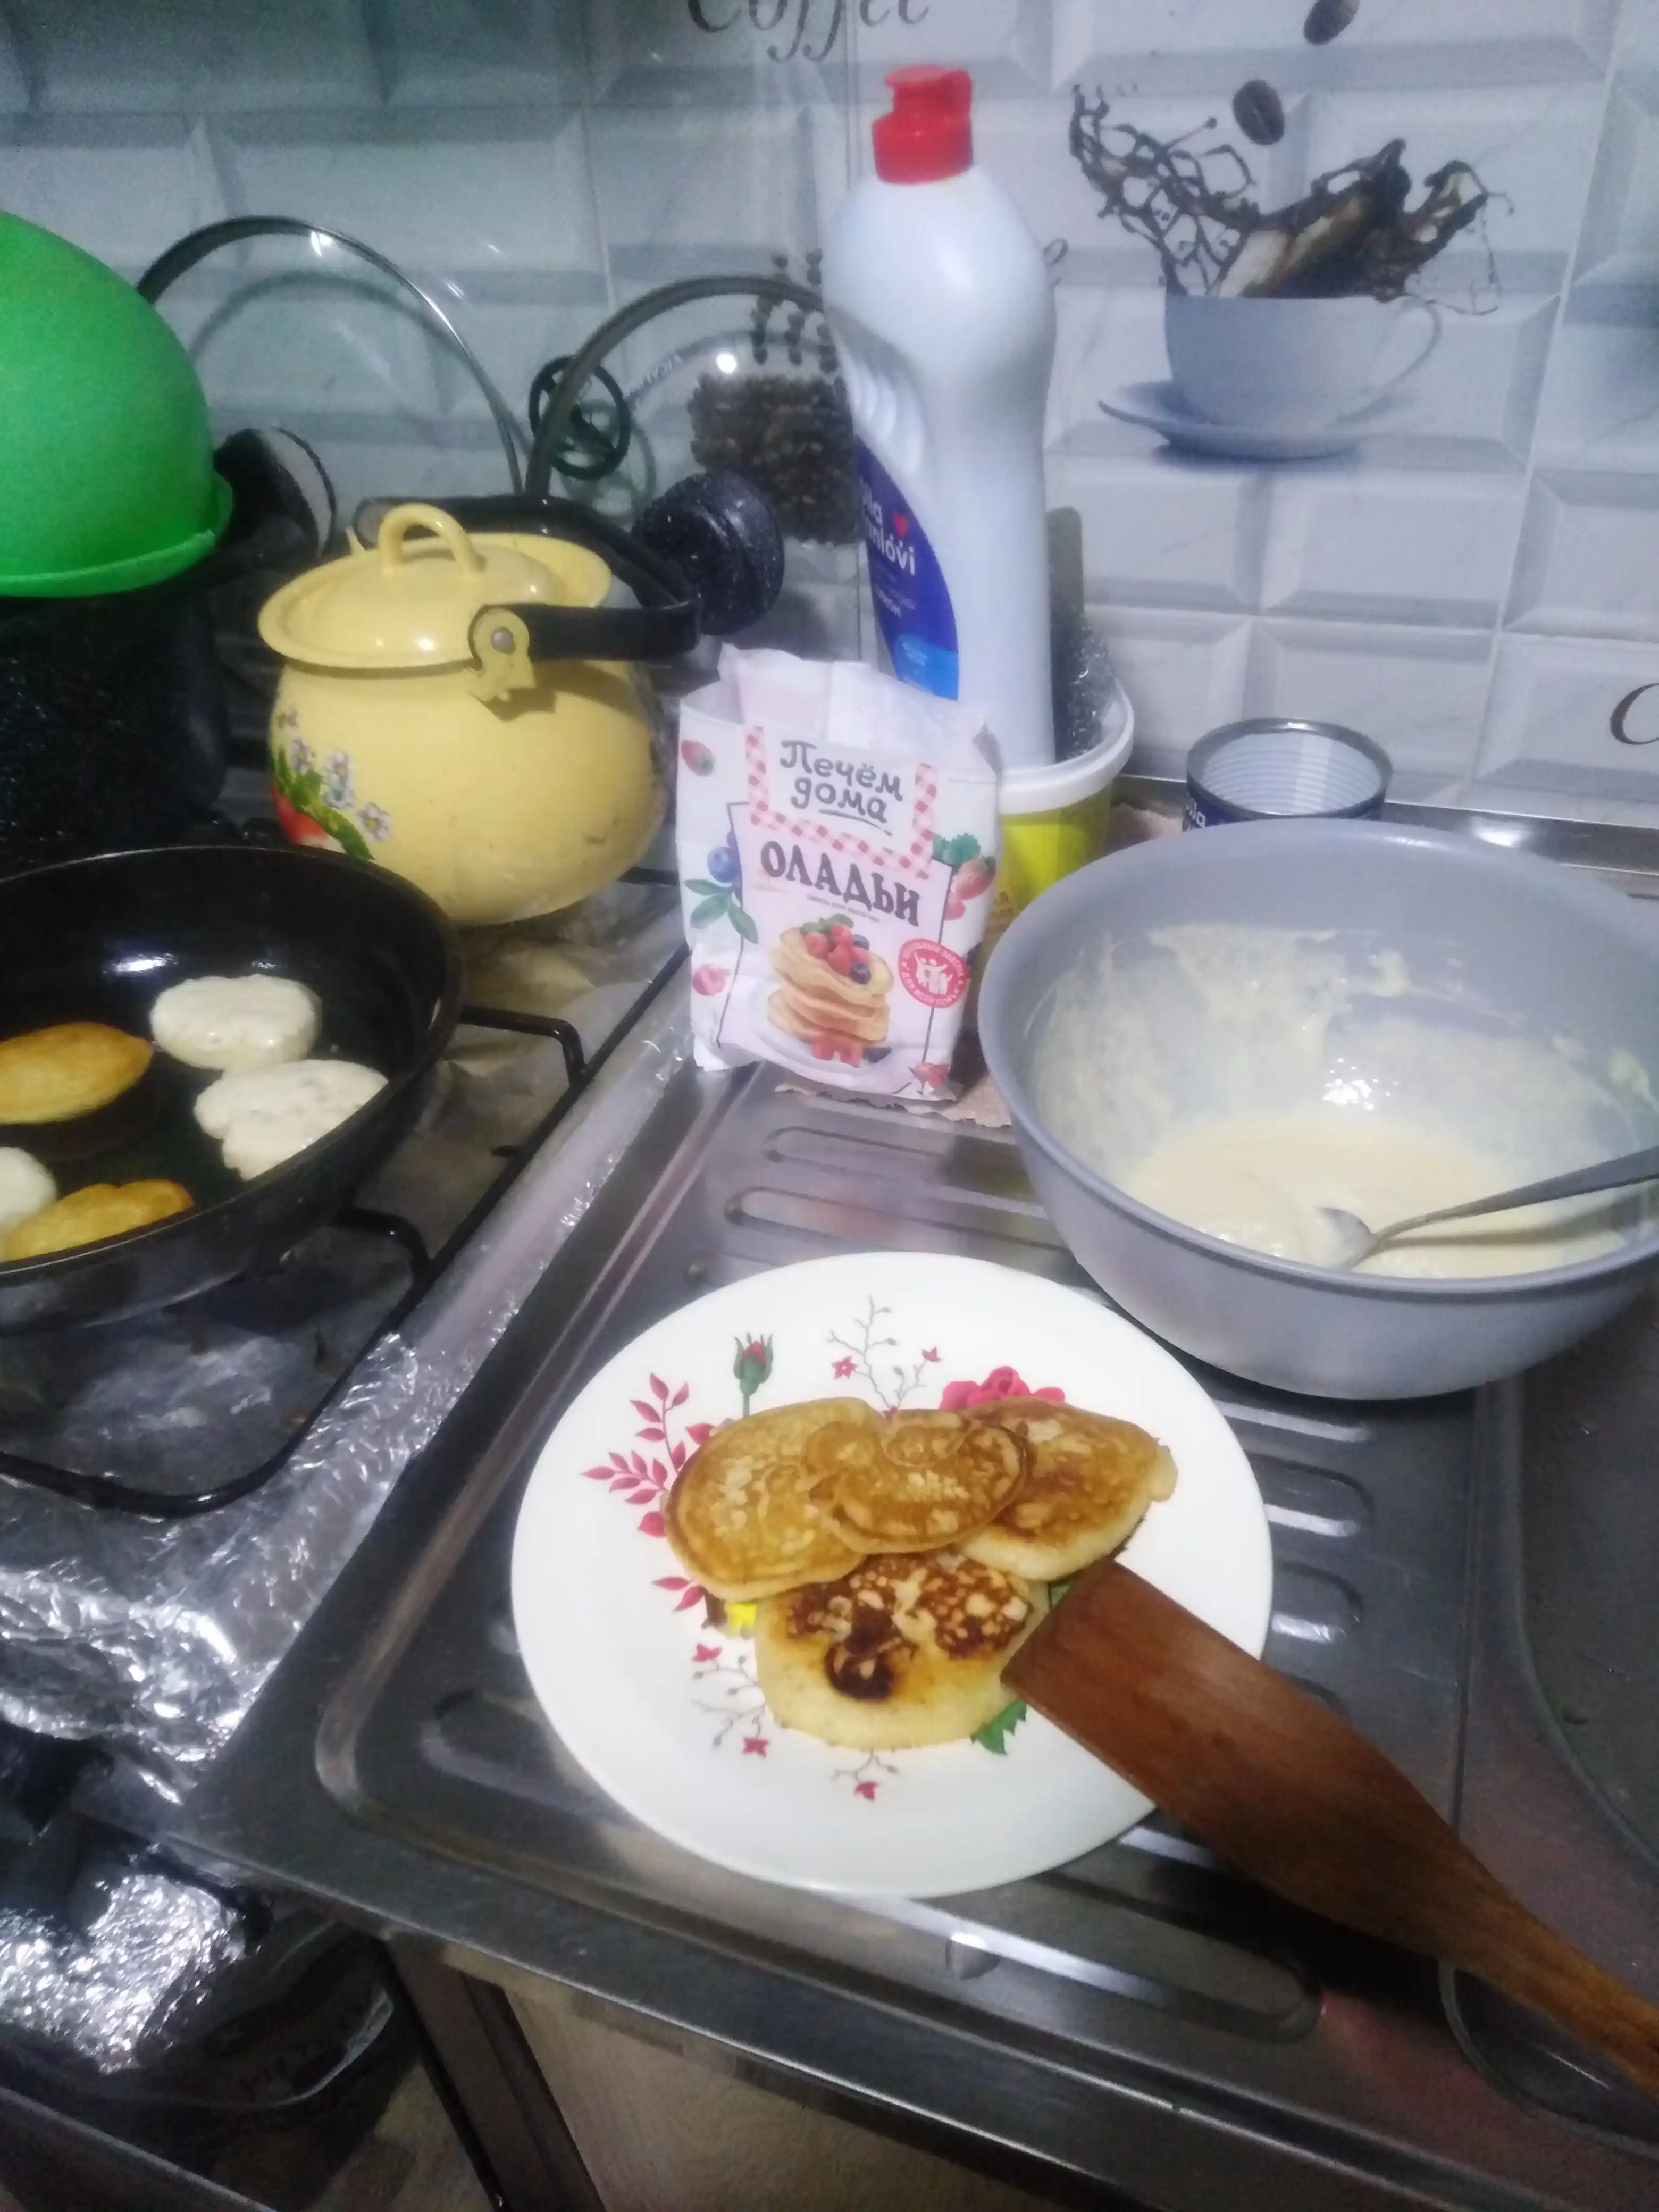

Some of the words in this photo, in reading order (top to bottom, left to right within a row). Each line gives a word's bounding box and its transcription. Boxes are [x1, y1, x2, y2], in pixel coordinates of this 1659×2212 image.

[780, 739, 903, 802] Печём
[790, 777, 887, 824] дома
[760, 841, 920, 927] ОЛАДЬИ
